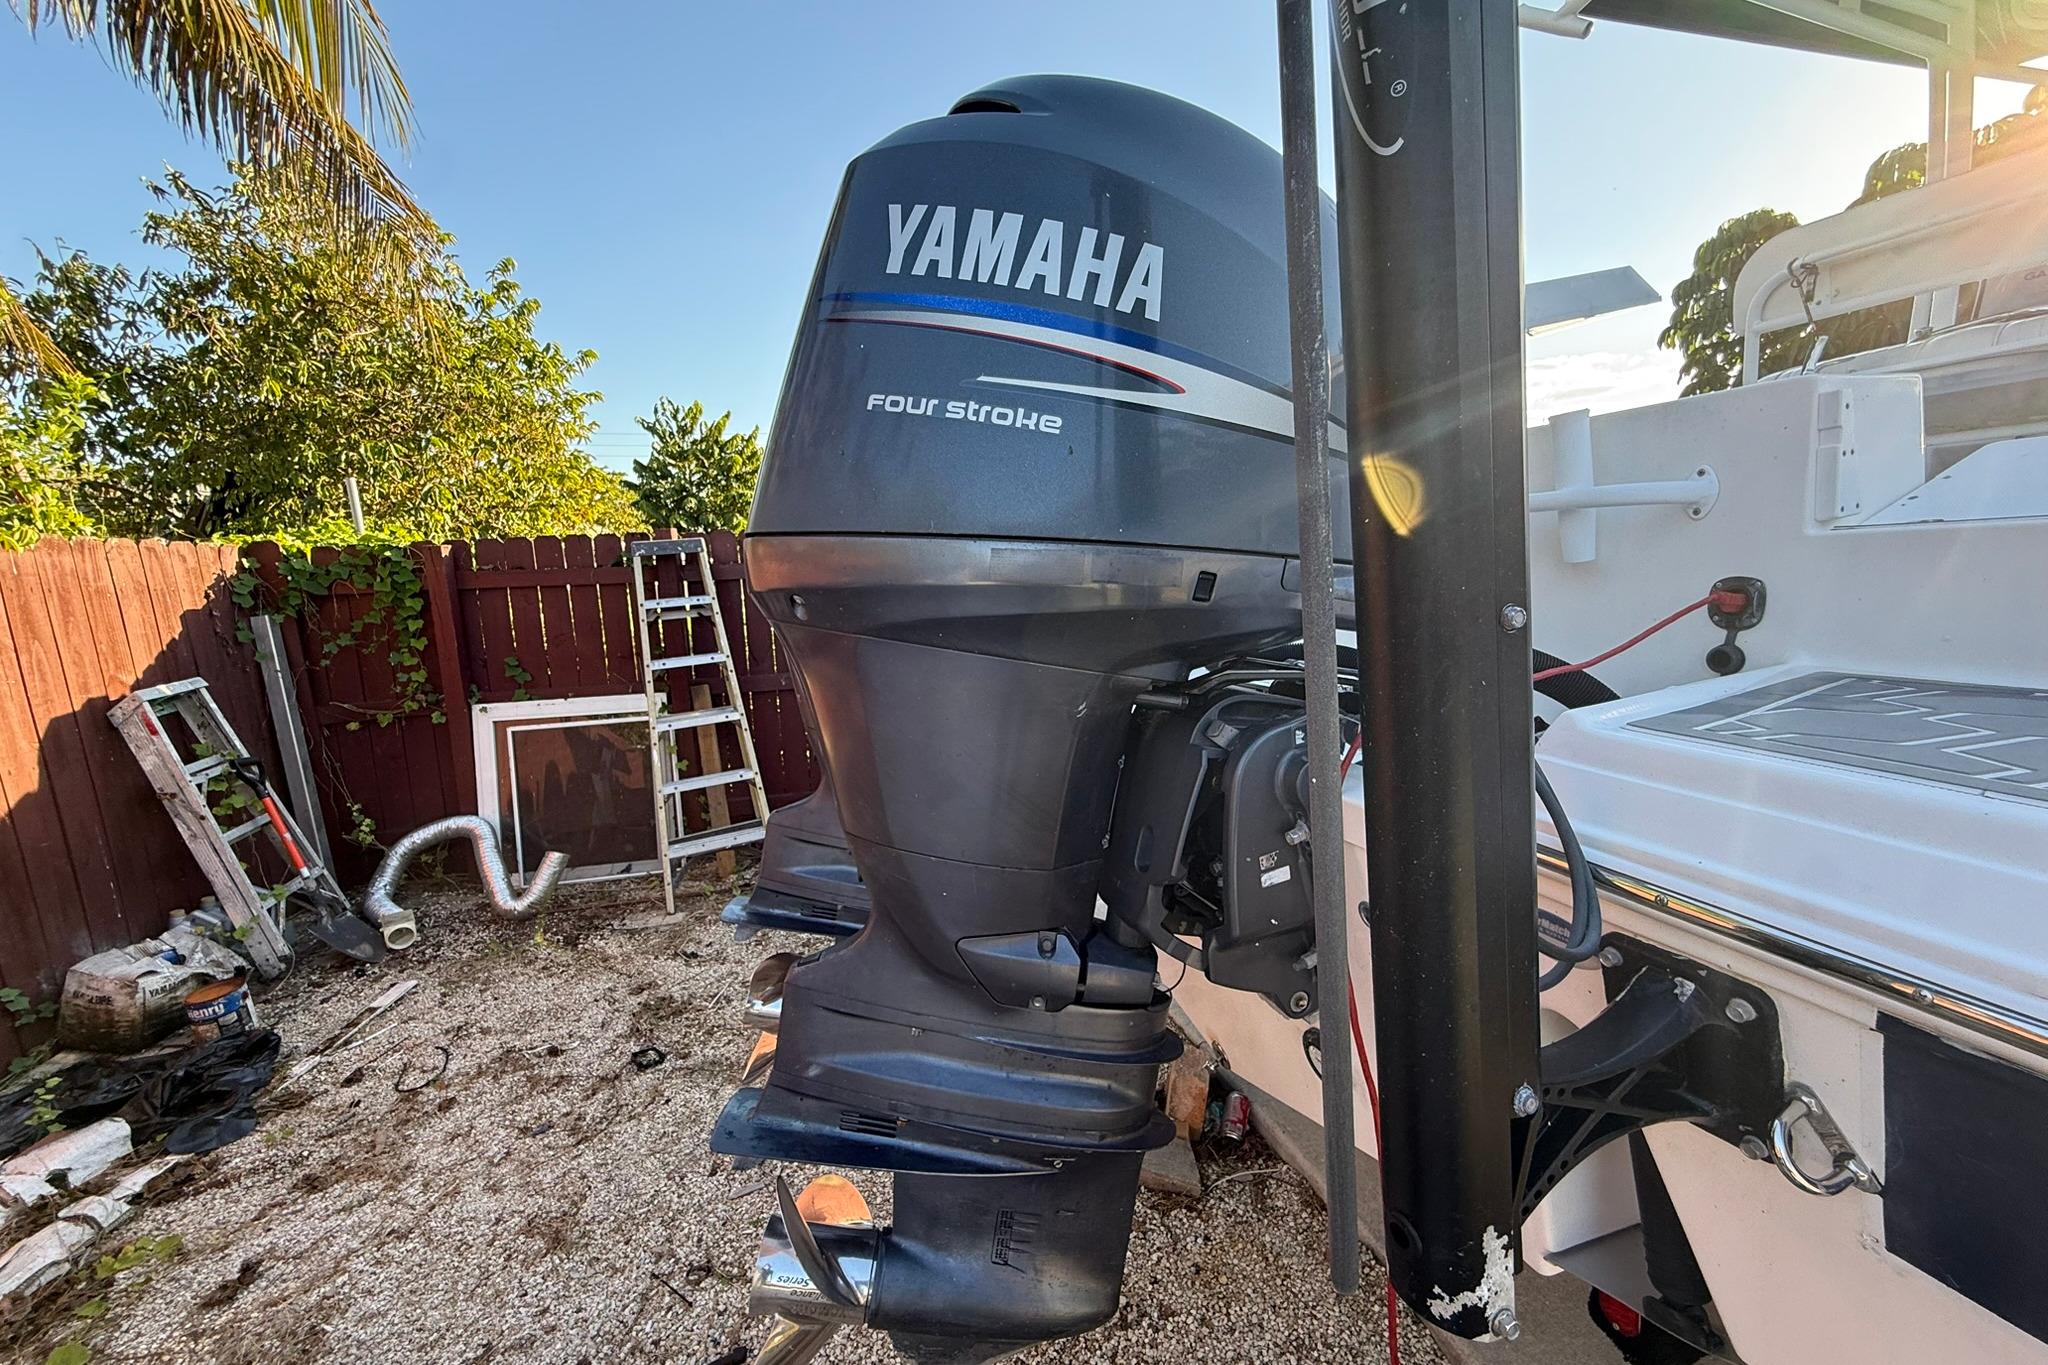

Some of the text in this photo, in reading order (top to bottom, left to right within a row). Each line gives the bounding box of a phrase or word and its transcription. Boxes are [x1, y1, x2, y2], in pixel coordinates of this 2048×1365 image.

[885, 203, 1165, 323] YAMAHA
[945, 400, 1063, 434] stroke
[776, 1275, 811, 1288] Series
